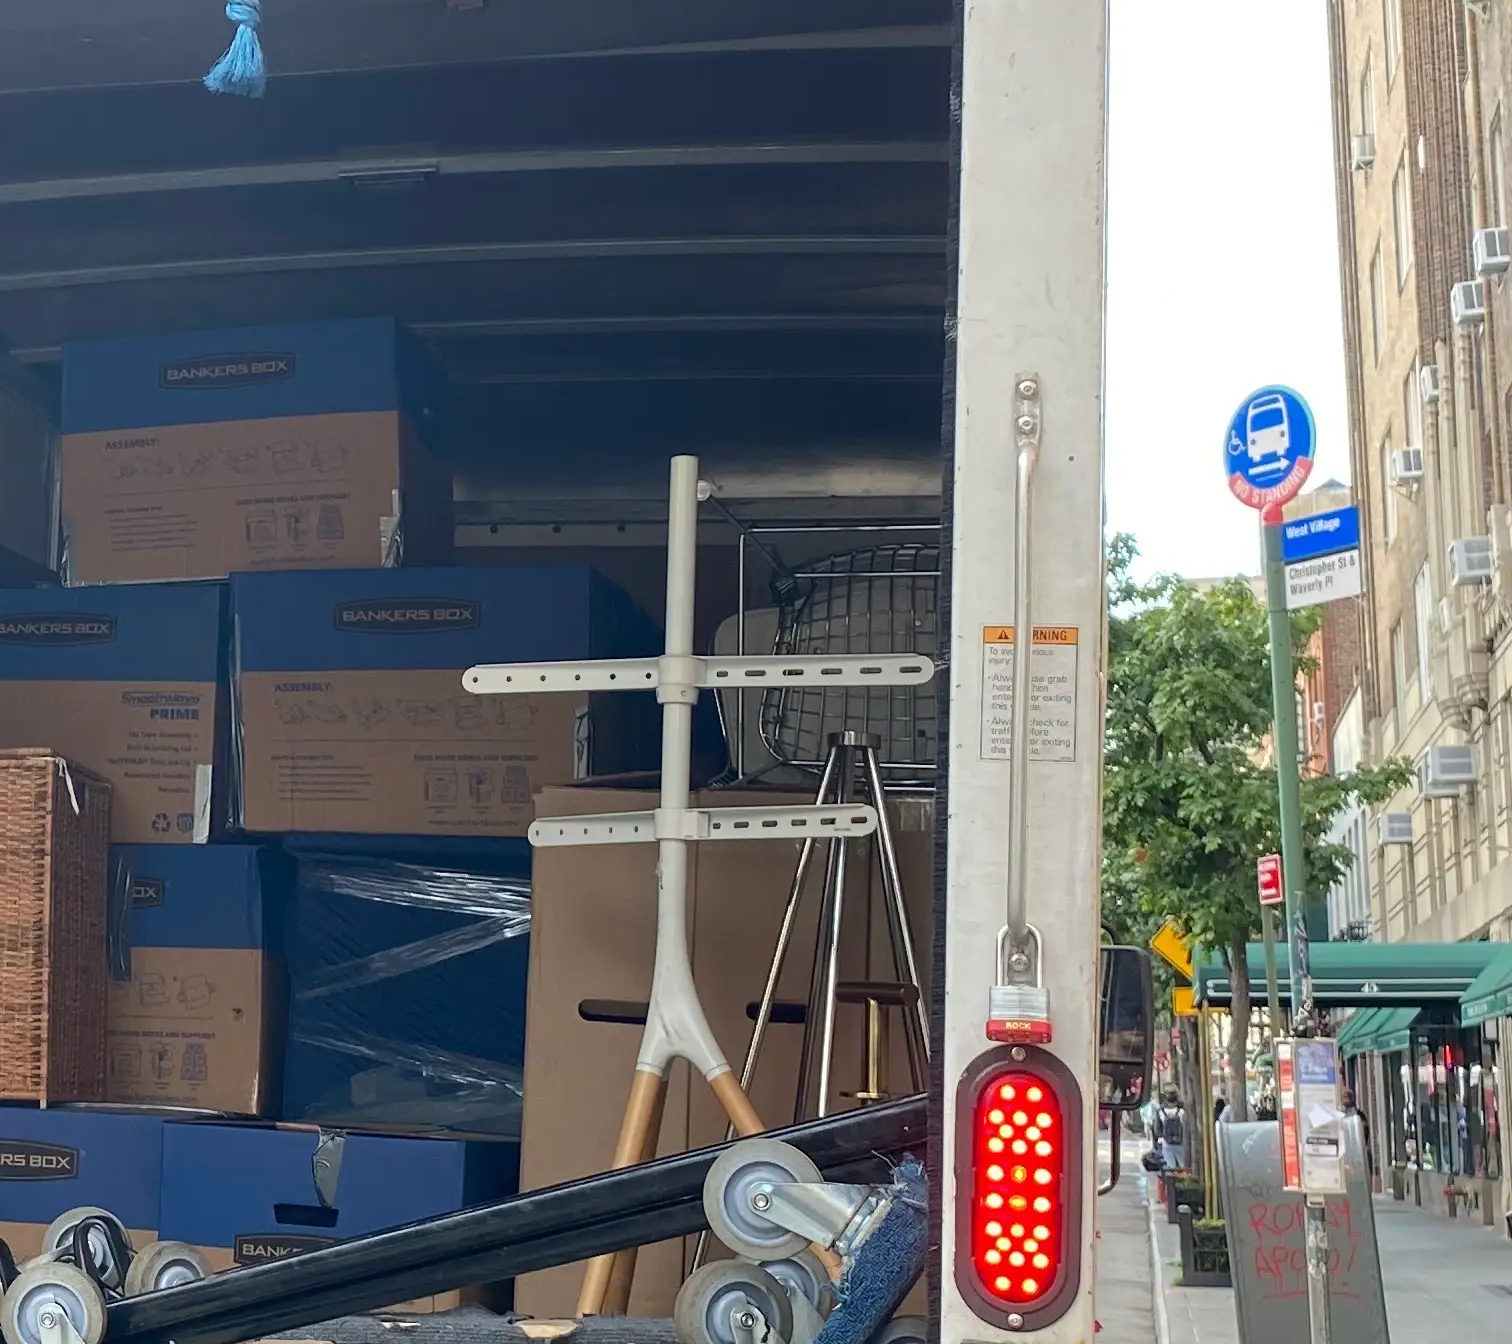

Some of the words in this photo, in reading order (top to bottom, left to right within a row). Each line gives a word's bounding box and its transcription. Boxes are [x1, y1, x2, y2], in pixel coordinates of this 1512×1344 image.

[166, 362, 249, 381] BANKERS
[251, 359, 289, 373] BOX
[1234, 479, 1249, 499] NO
[1251, 464, 1305, 506] STANDING
[1285, 524, 1309, 540] West
[1310, 516, 1341, 534] Village
[1289, 561, 1336, 580] Christopher
[1338, 556, 1348, 569] St
[1349, 554, 1356, 567] &
[1289, 576, 1323, 596] Waverly
[1324, 575, 1334, 588] Pl
[342, 608, 430, 623] BANKERS
[432, 607, 473, 620] BOX
[73, 621, 112, 635] BOX
[1033, 629, 1068, 642] RNING
[989, 646, 999, 655] To
[274, 681, 335, 693] ASSEMBLY:
[1047, 676, 1068, 685] grab
[1032, 684, 1049, 692] hen
[149, 708, 200, 720] PRIME
[1056, 719, 1069, 727] for
[131, 885, 158, 899] OX
[1005, 1021, 1032, 1030] ROCK
[28, 1153, 72, 1171] BOX
[241, 1243, 304, 1258] BANK
